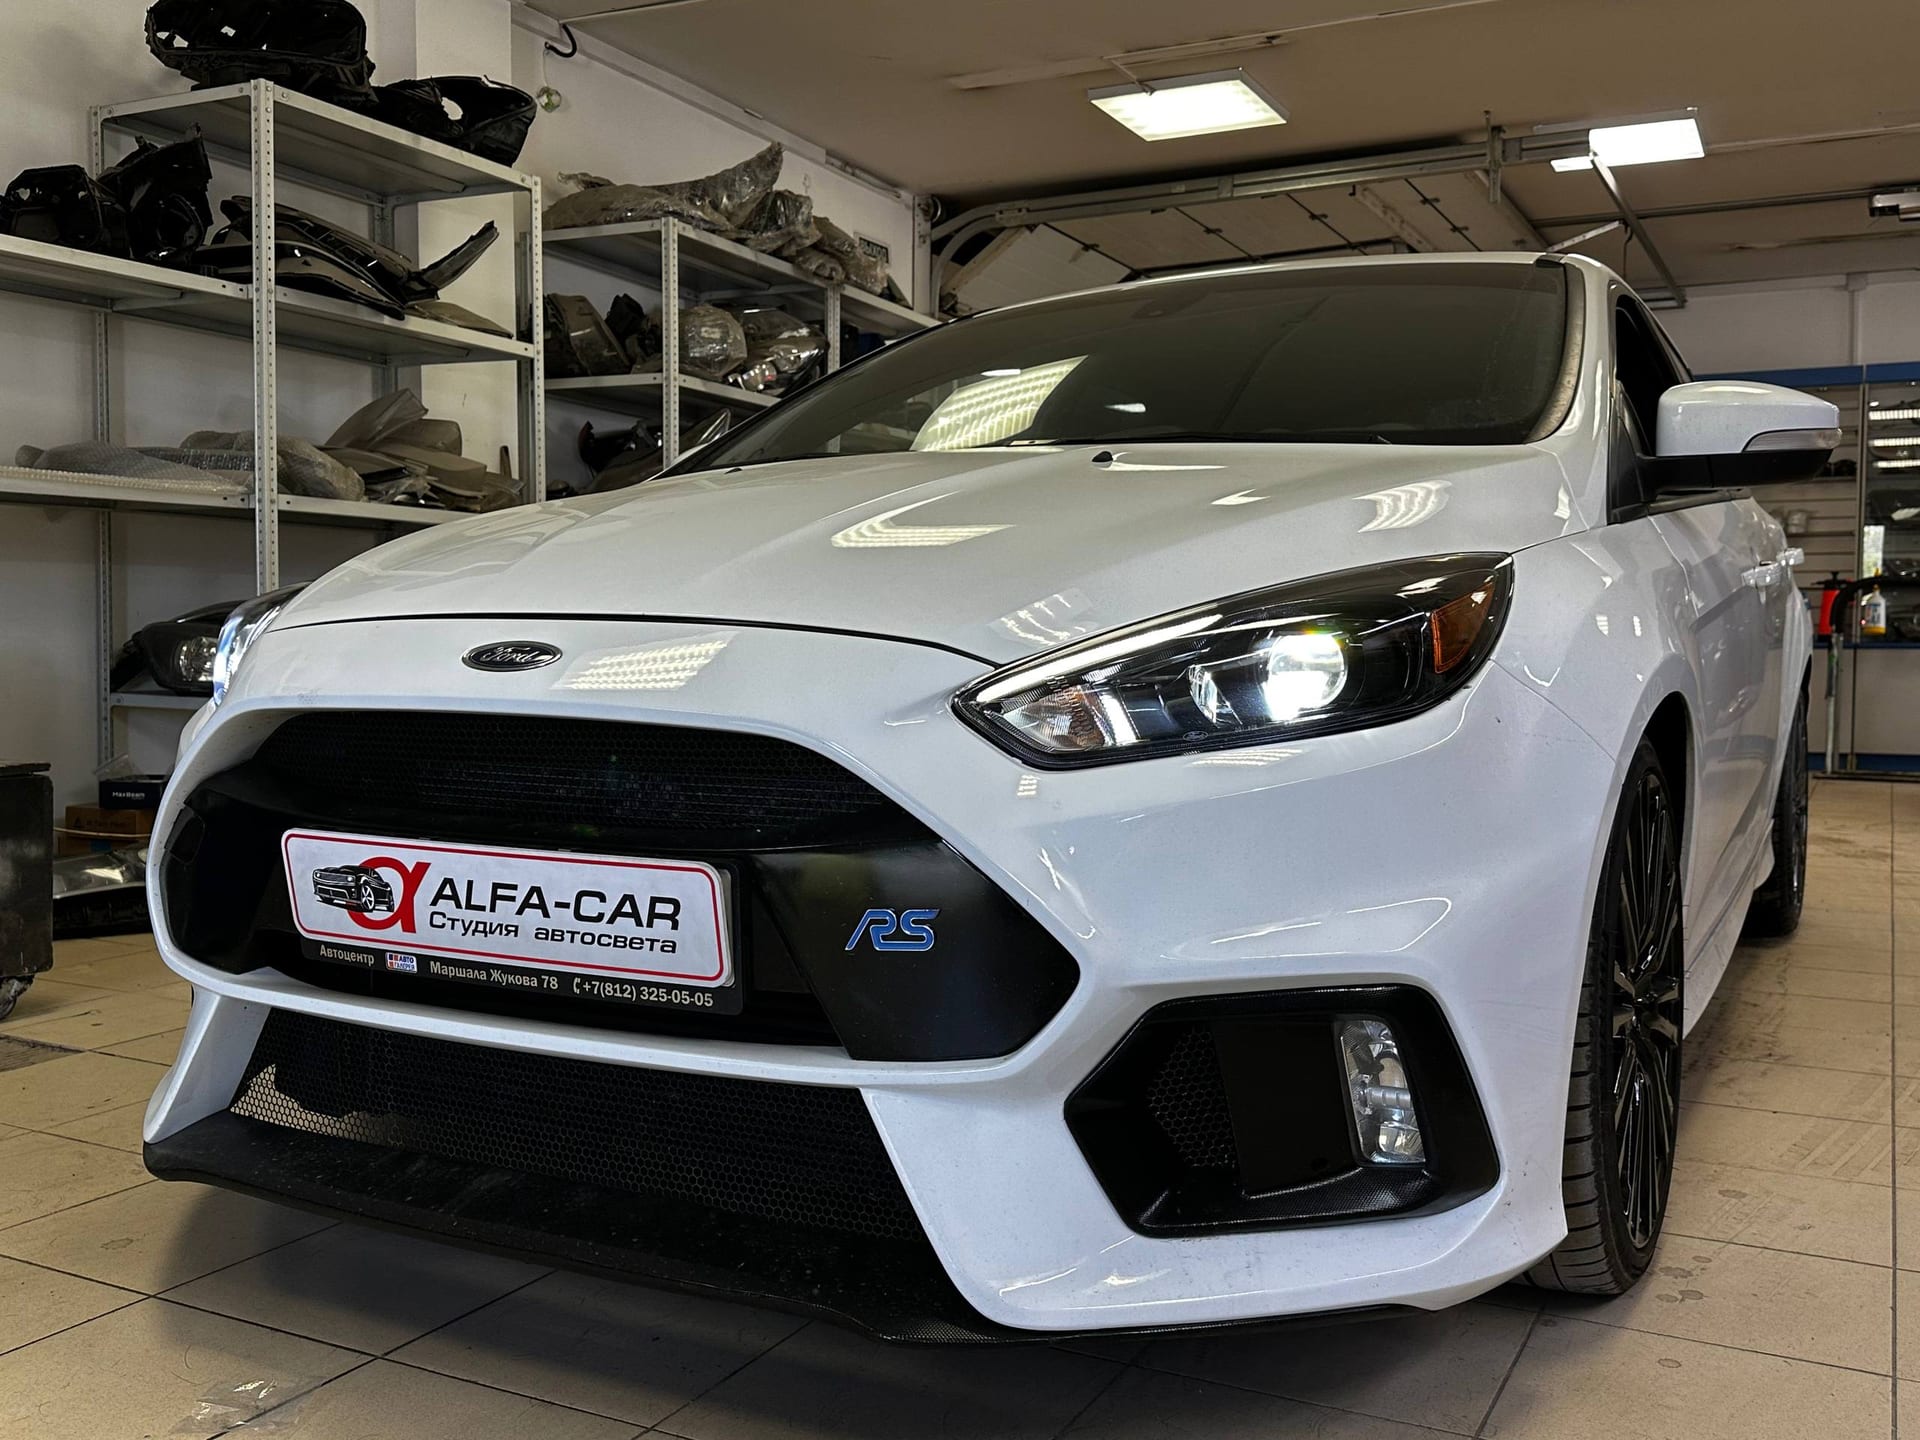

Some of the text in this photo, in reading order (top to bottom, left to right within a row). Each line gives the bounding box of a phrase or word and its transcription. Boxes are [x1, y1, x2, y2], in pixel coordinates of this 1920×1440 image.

[481, 646, 541, 663] Ford
[429, 877, 682, 931] ALFA-CAR
[429, 911, 678, 955] Студия автосвета
[844, 908, 941, 952] RS
[320, 944, 375, 967] Автоцентр
[430, 960, 559, 990] Маршала Жукова 78
[582, 980, 714, 1007] +7(812) 325-05-05
